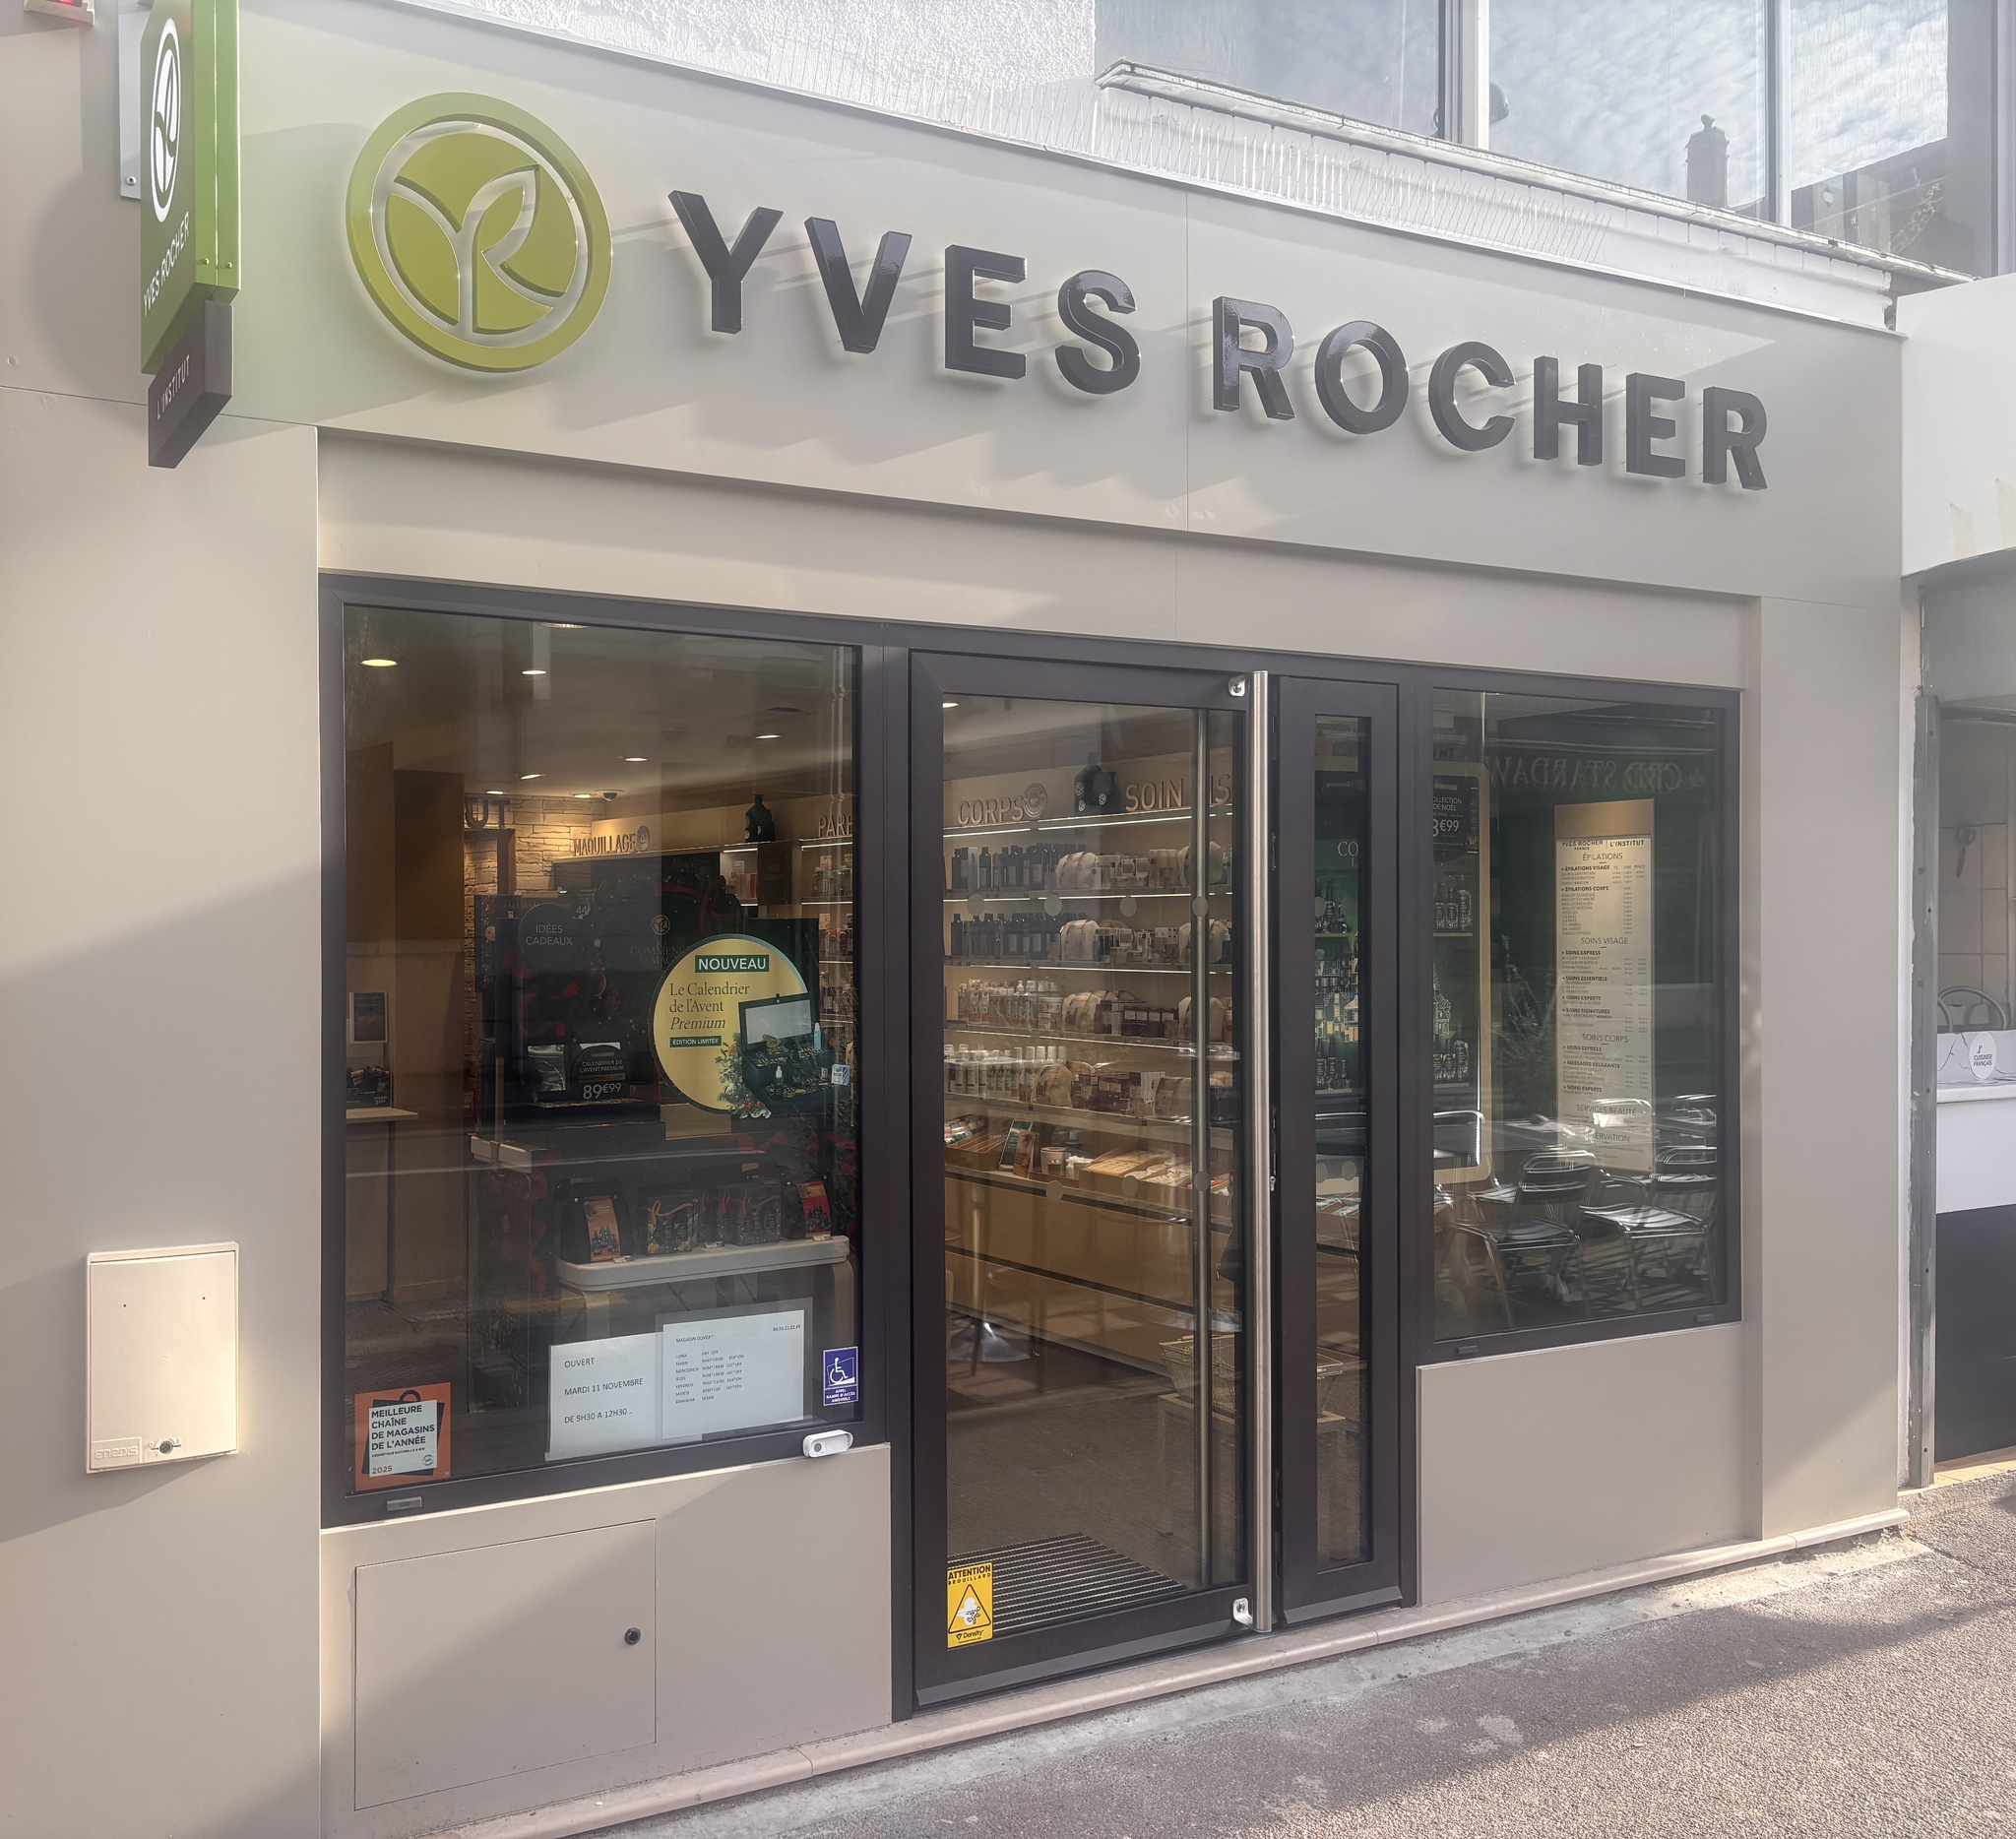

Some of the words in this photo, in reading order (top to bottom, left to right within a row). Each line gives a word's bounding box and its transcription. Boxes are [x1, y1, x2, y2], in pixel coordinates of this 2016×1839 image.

[143, 272, 160, 317] YVES
[160, 210, 190, 284] ROCHER
[667, 190, 1141, 394] YVES
[1213, 296, 1768, 490] ROCHER
[156, 353, 191, 420] L'INSTITUT
[1125, 779, 1184, 812] SOIN
[1211, 774, 1230, 806] IS
[957, 794, 1024, 827] CORPS
[573, 833, 637, 856] MAQUILLAGE
[536, 922, 563, 933] IDÉES
[525, 936, 573, 946] CADEAUX
[630, 946, 687, 956] COMMENC
[698, 957, 767, 971] NOUVEAU
[669, 983, 685, 996] Le
[687, 982, 750, 996] Calendrier
[669, 999, 684, 1013] de
[686, 998, 724, 1013] l'Avent
[669, 1017, 725, 1030] Premium
[583, 1082, 622, 1100] 89€99
[1576, 1105, 1607, 1113] SERVICES
[1587, 1131, 1630, 1142] ERVATION
[564, 1357, 595, 1367] OUVERT
[564, 1385, 590, 1395] MARDI
[602, 1377, 643, 1390] NOVEMBRE
[371, 1405, 422, 1419] MEILLEURE
[564, 1415, 574, 1424] DE
[576, 1412, 596, 1422] 9H30
[371, 1418, 408, 1428] CHAÎNE
[371, 1431, 384, 1440] DE
[386, 1425, 435, 1438] MAGASINS
[371, 1441, 384, 1450] DE
[386, 1435, 426, 1449] L'ANNÉE
[371, 1465, 393, 1475] 2025
[948, 1563, 991, 1580] ATTENTION
[948, 1572, 991, 1586] BROUILLARD
[963, 1629, 982, 1638] Density
